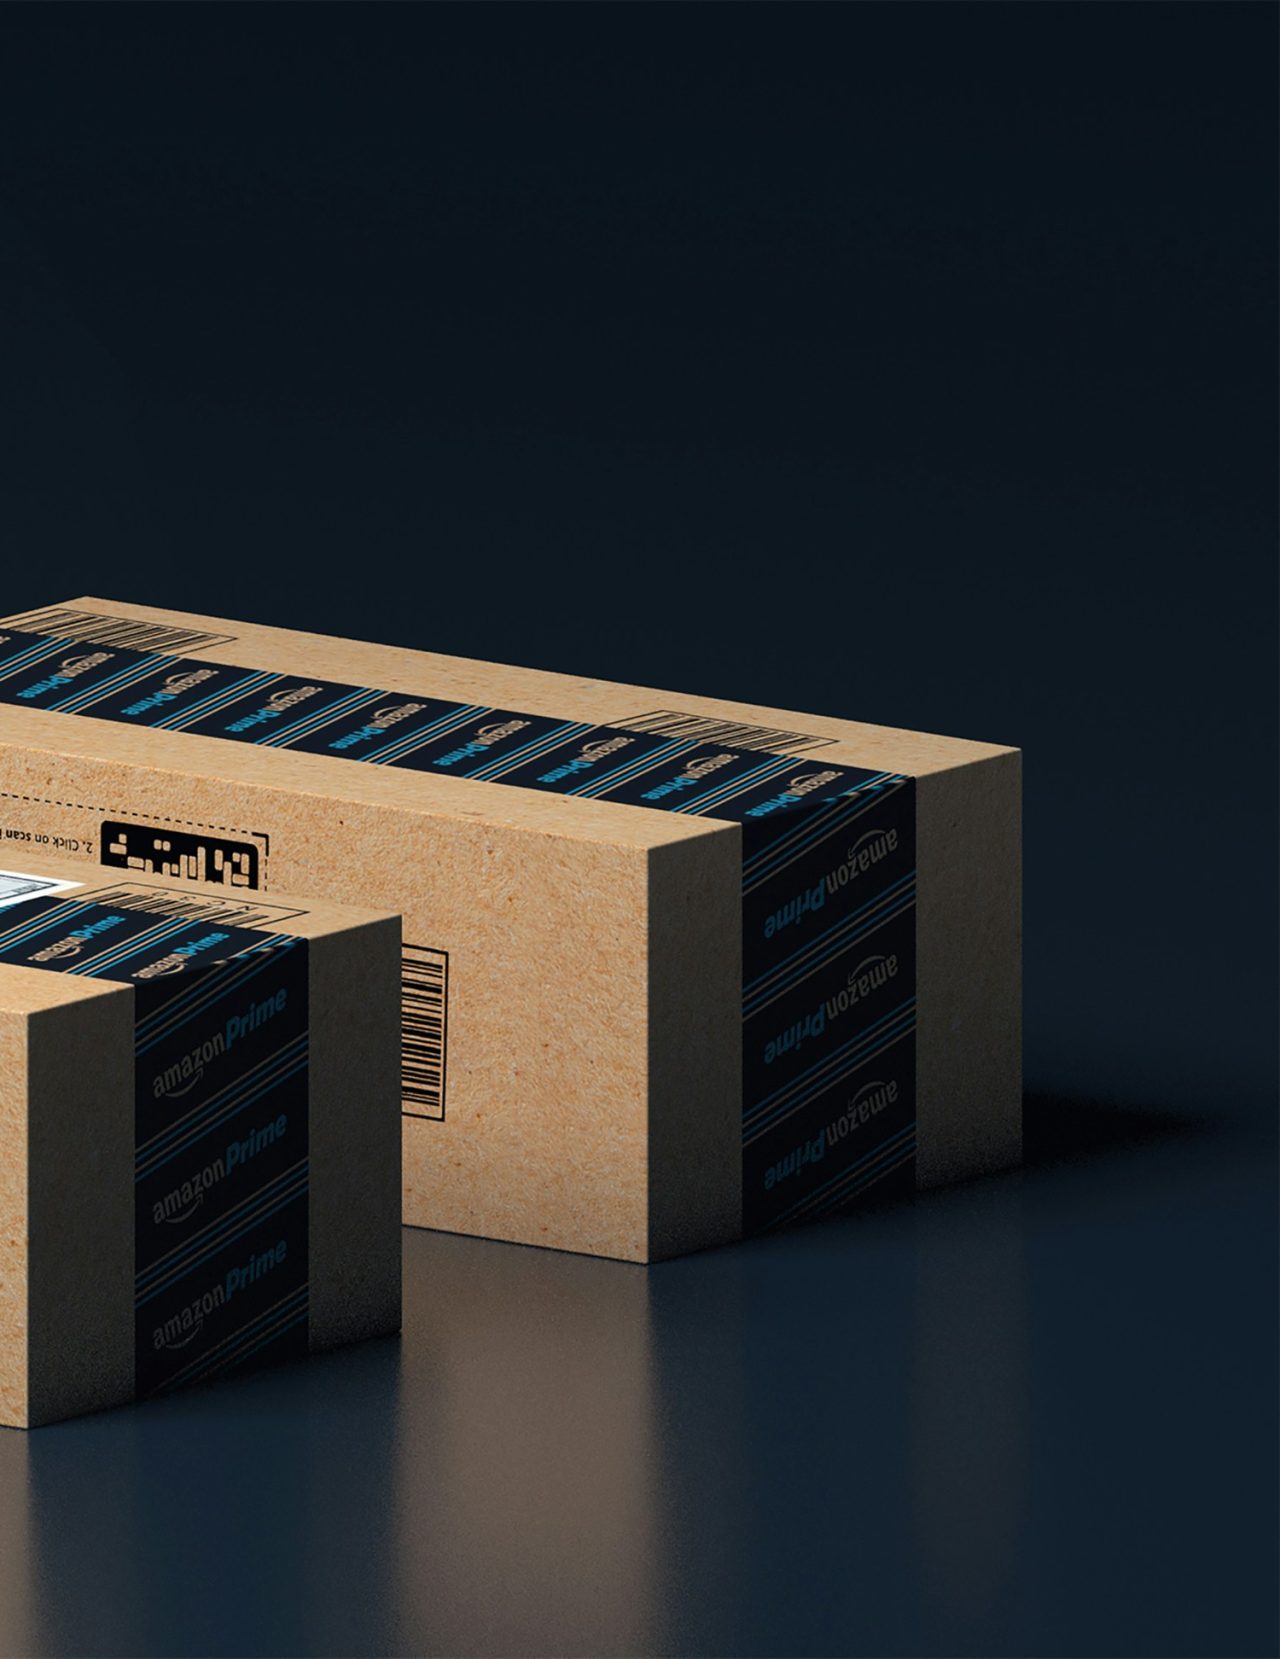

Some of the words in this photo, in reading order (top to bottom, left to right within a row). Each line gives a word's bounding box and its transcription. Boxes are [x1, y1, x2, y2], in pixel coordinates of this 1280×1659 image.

[5, 829, 32, 842] scan
[34, 834, 50, 845] on
[52, 836, 80, 852] Click
[82, 841, 94, 854] 2.
